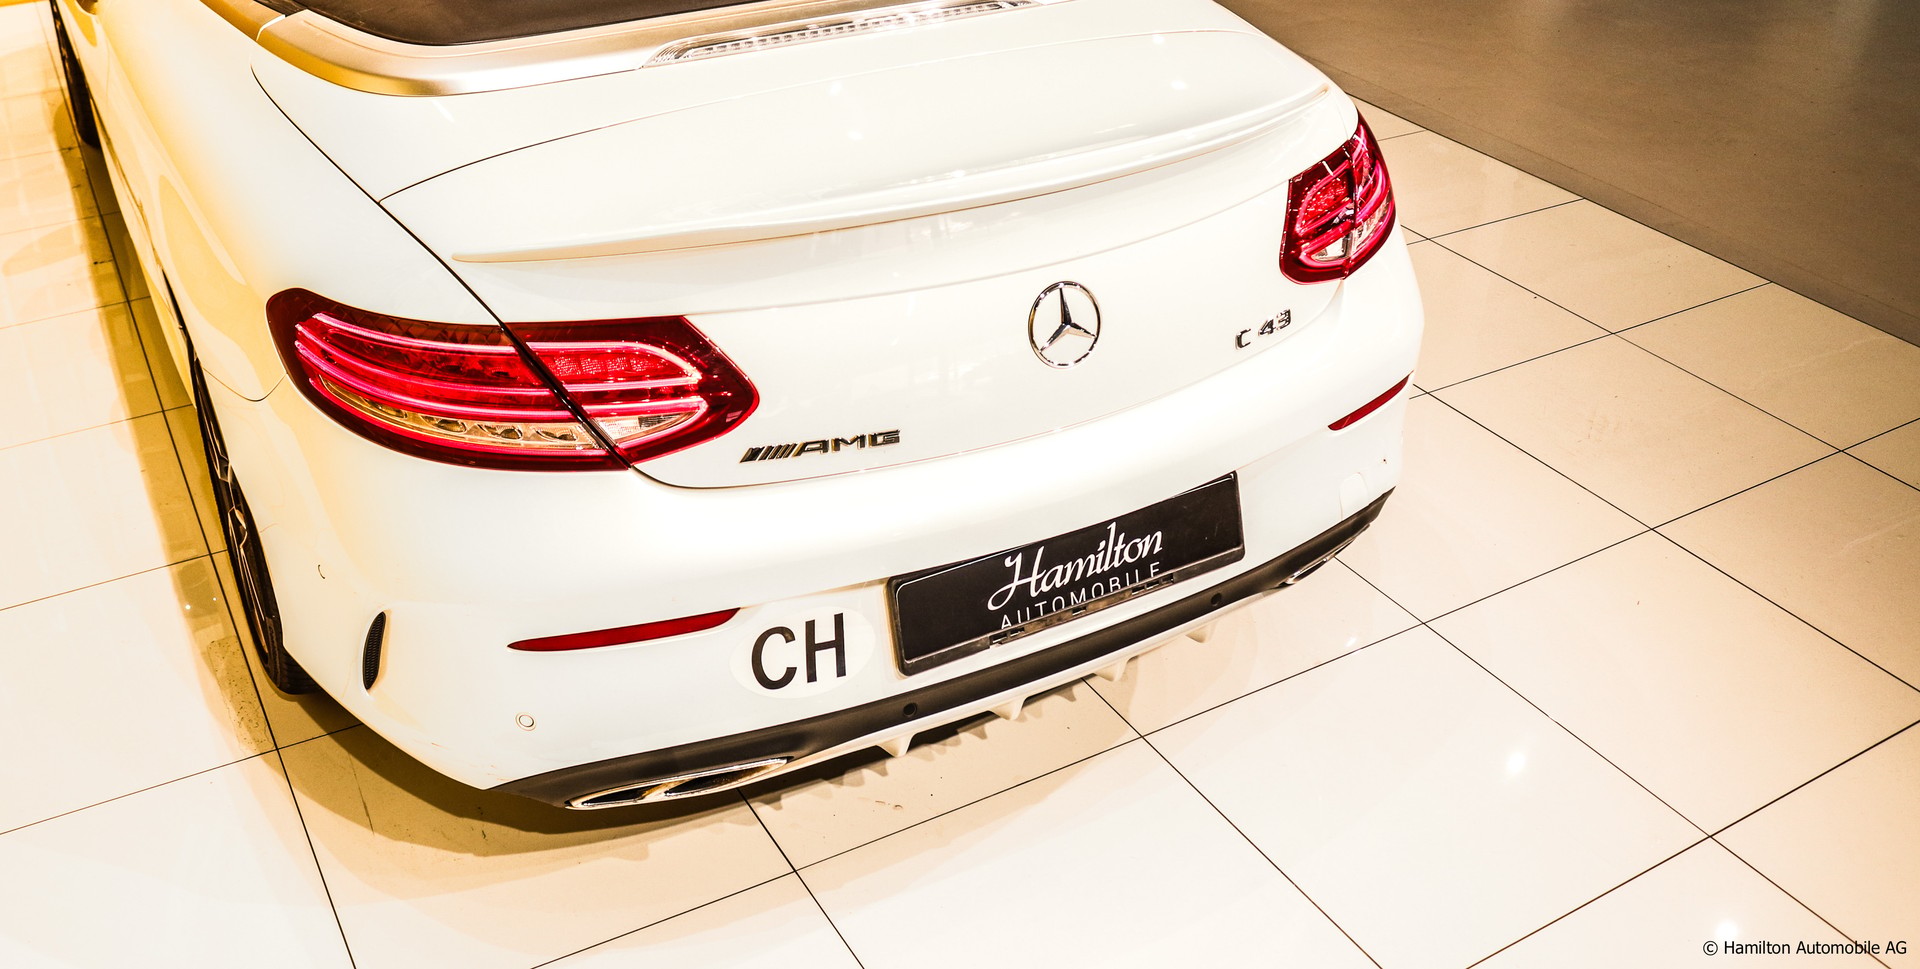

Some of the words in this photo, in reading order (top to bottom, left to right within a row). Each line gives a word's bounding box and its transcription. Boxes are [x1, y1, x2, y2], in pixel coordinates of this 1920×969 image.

[1235, 328, 1251, 349] C
[1258, 308, 1292, 336] 43
[987, 521, 1163, 611] Hamilton
[751, 612, 847, 690] CH
